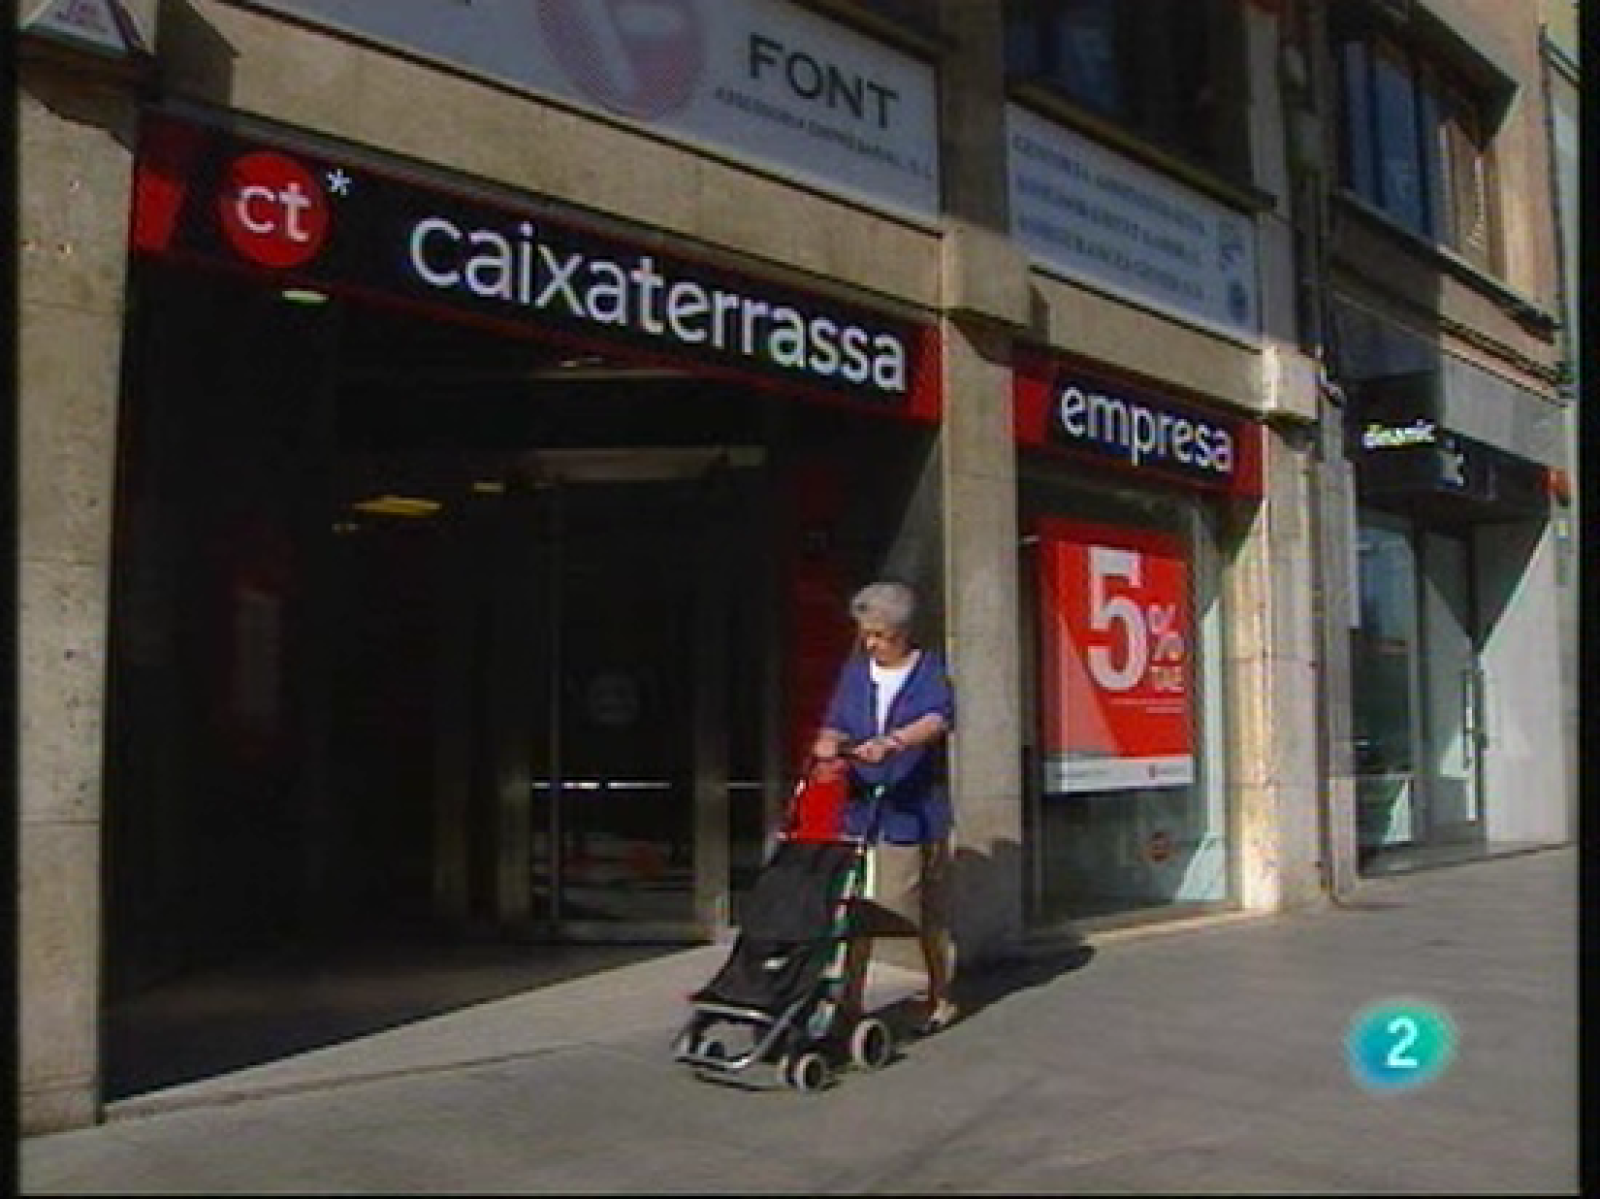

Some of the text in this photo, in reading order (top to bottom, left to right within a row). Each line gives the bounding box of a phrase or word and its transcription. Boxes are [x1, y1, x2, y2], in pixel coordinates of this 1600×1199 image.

[748, 32, 899, 129] FONT
[234, 182, 311, 243] ct
[408, 215, 906, 393] caixaterrassa
[1061, 386, 1234, 472] empresa
